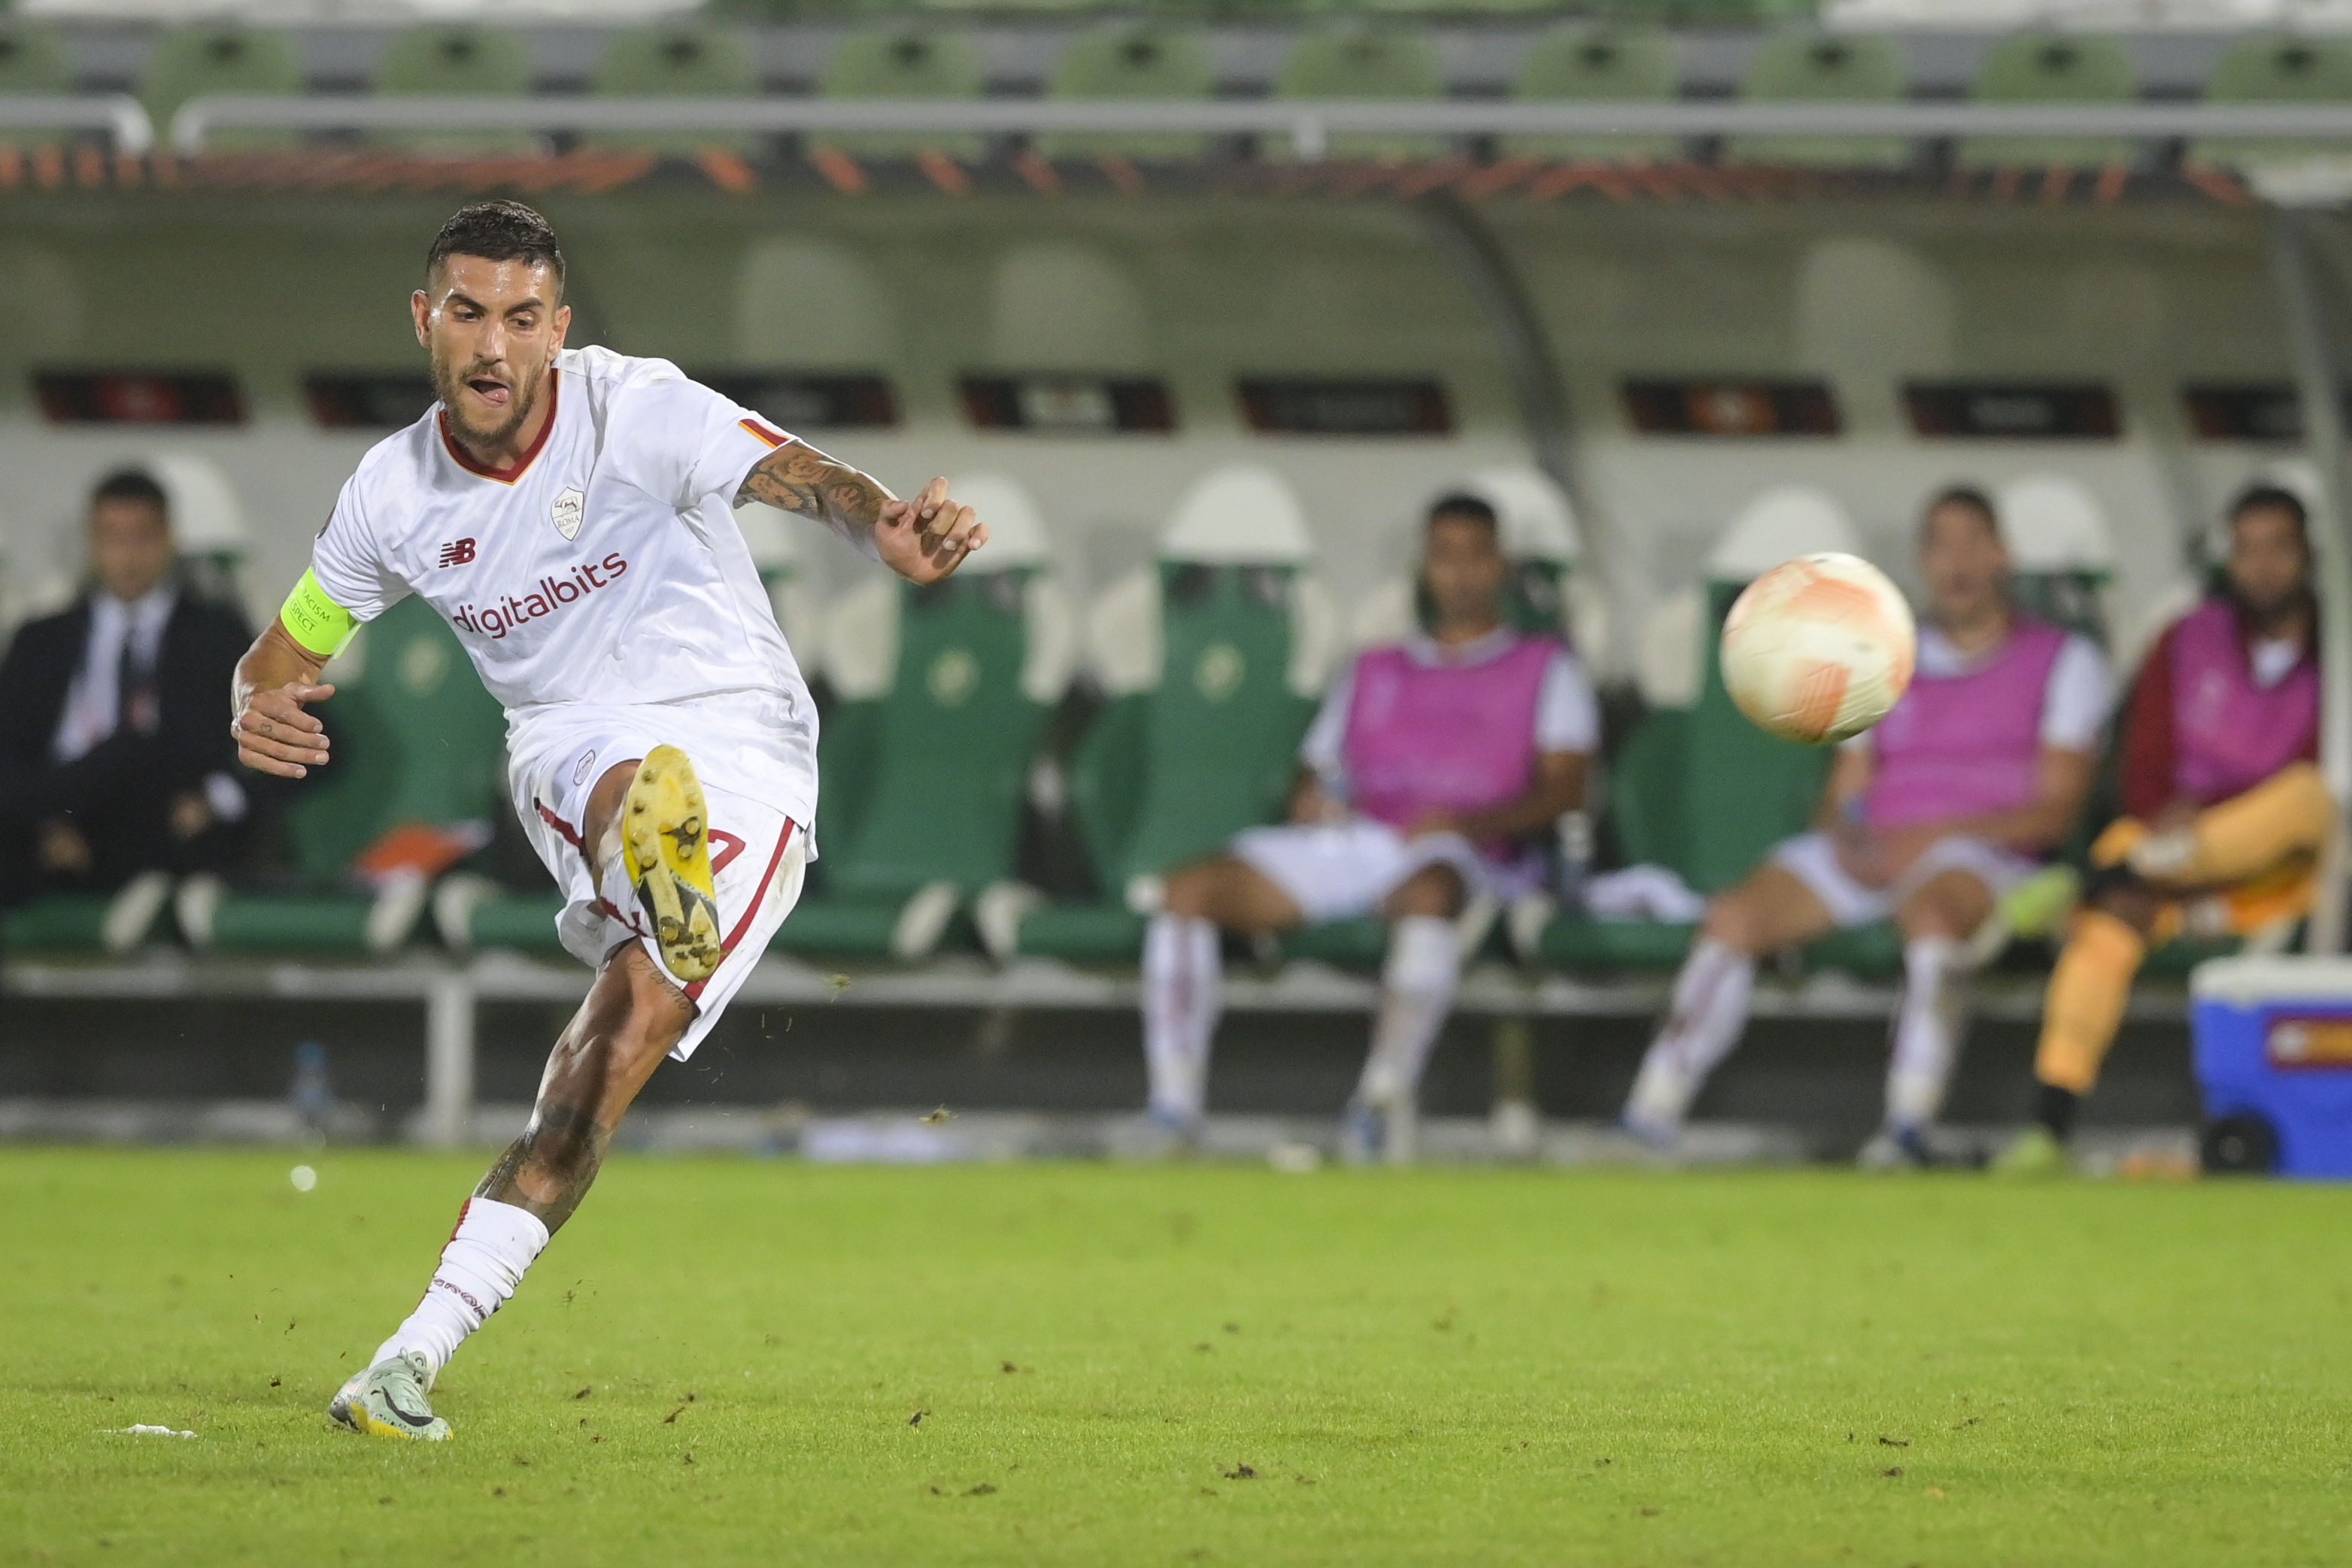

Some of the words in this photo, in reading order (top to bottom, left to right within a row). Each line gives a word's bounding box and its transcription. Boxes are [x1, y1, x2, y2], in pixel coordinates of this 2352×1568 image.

[557, 515, 579, 528] ROMA
[453, 553, 627, 639] digitalbits
[708, 829, 747, 878] 7
